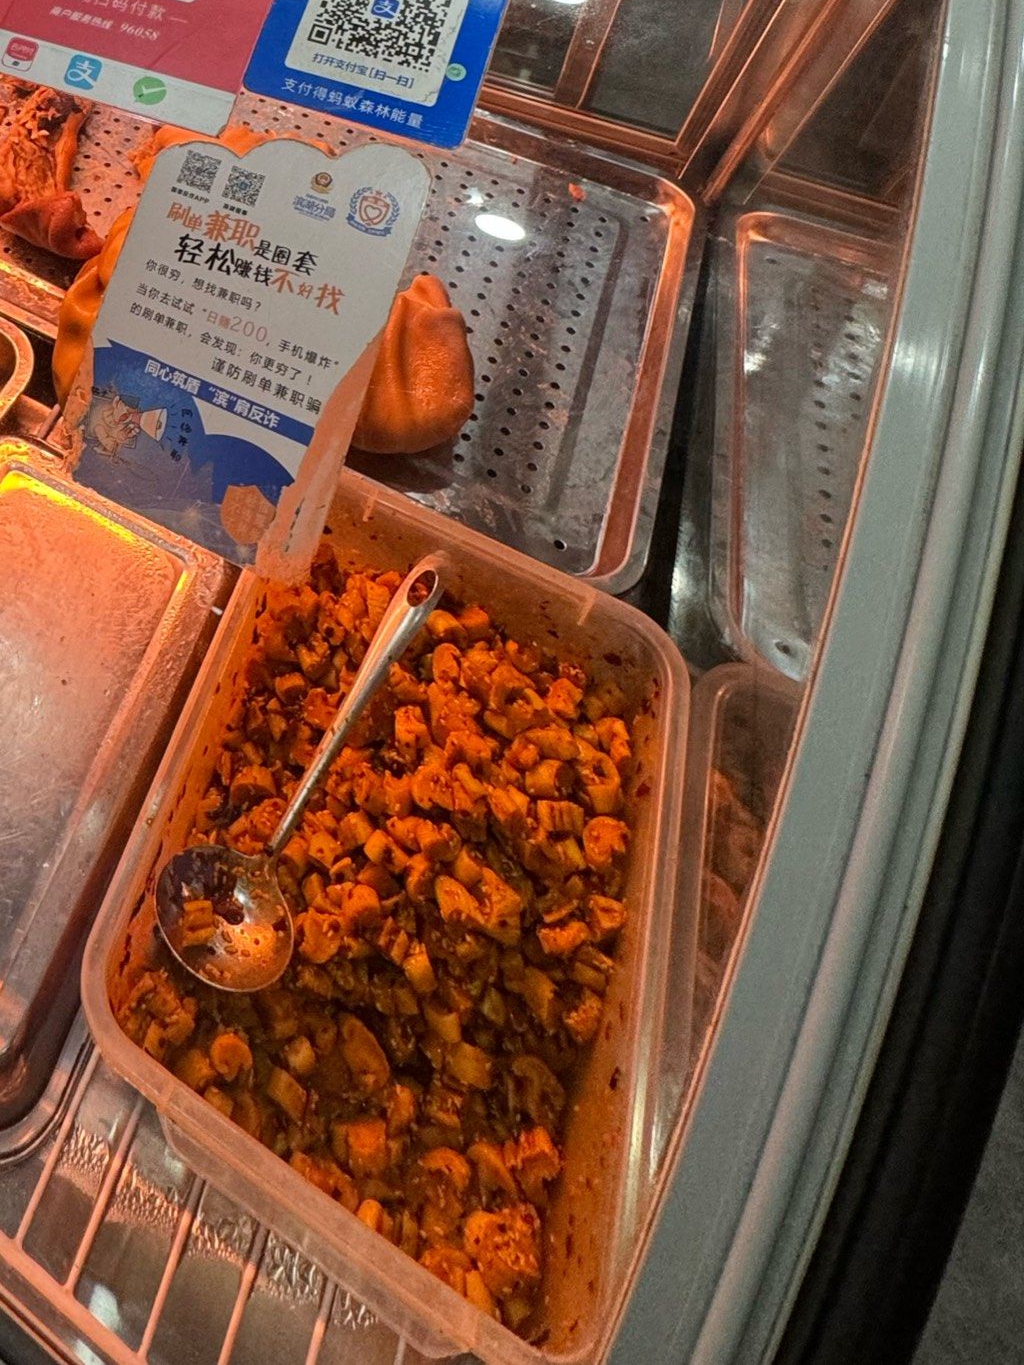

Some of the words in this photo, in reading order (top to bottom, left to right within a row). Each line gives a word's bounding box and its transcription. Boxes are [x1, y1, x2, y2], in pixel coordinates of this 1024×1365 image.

[120, 22, 160, 41] 96058
[281, 77, 424, 129] 支付得蚂蚁森林能量
[167, 202, 319, 276] 刷单兼职是圈套
[174, 234, 345, 316] 轻松赚钱不好找
